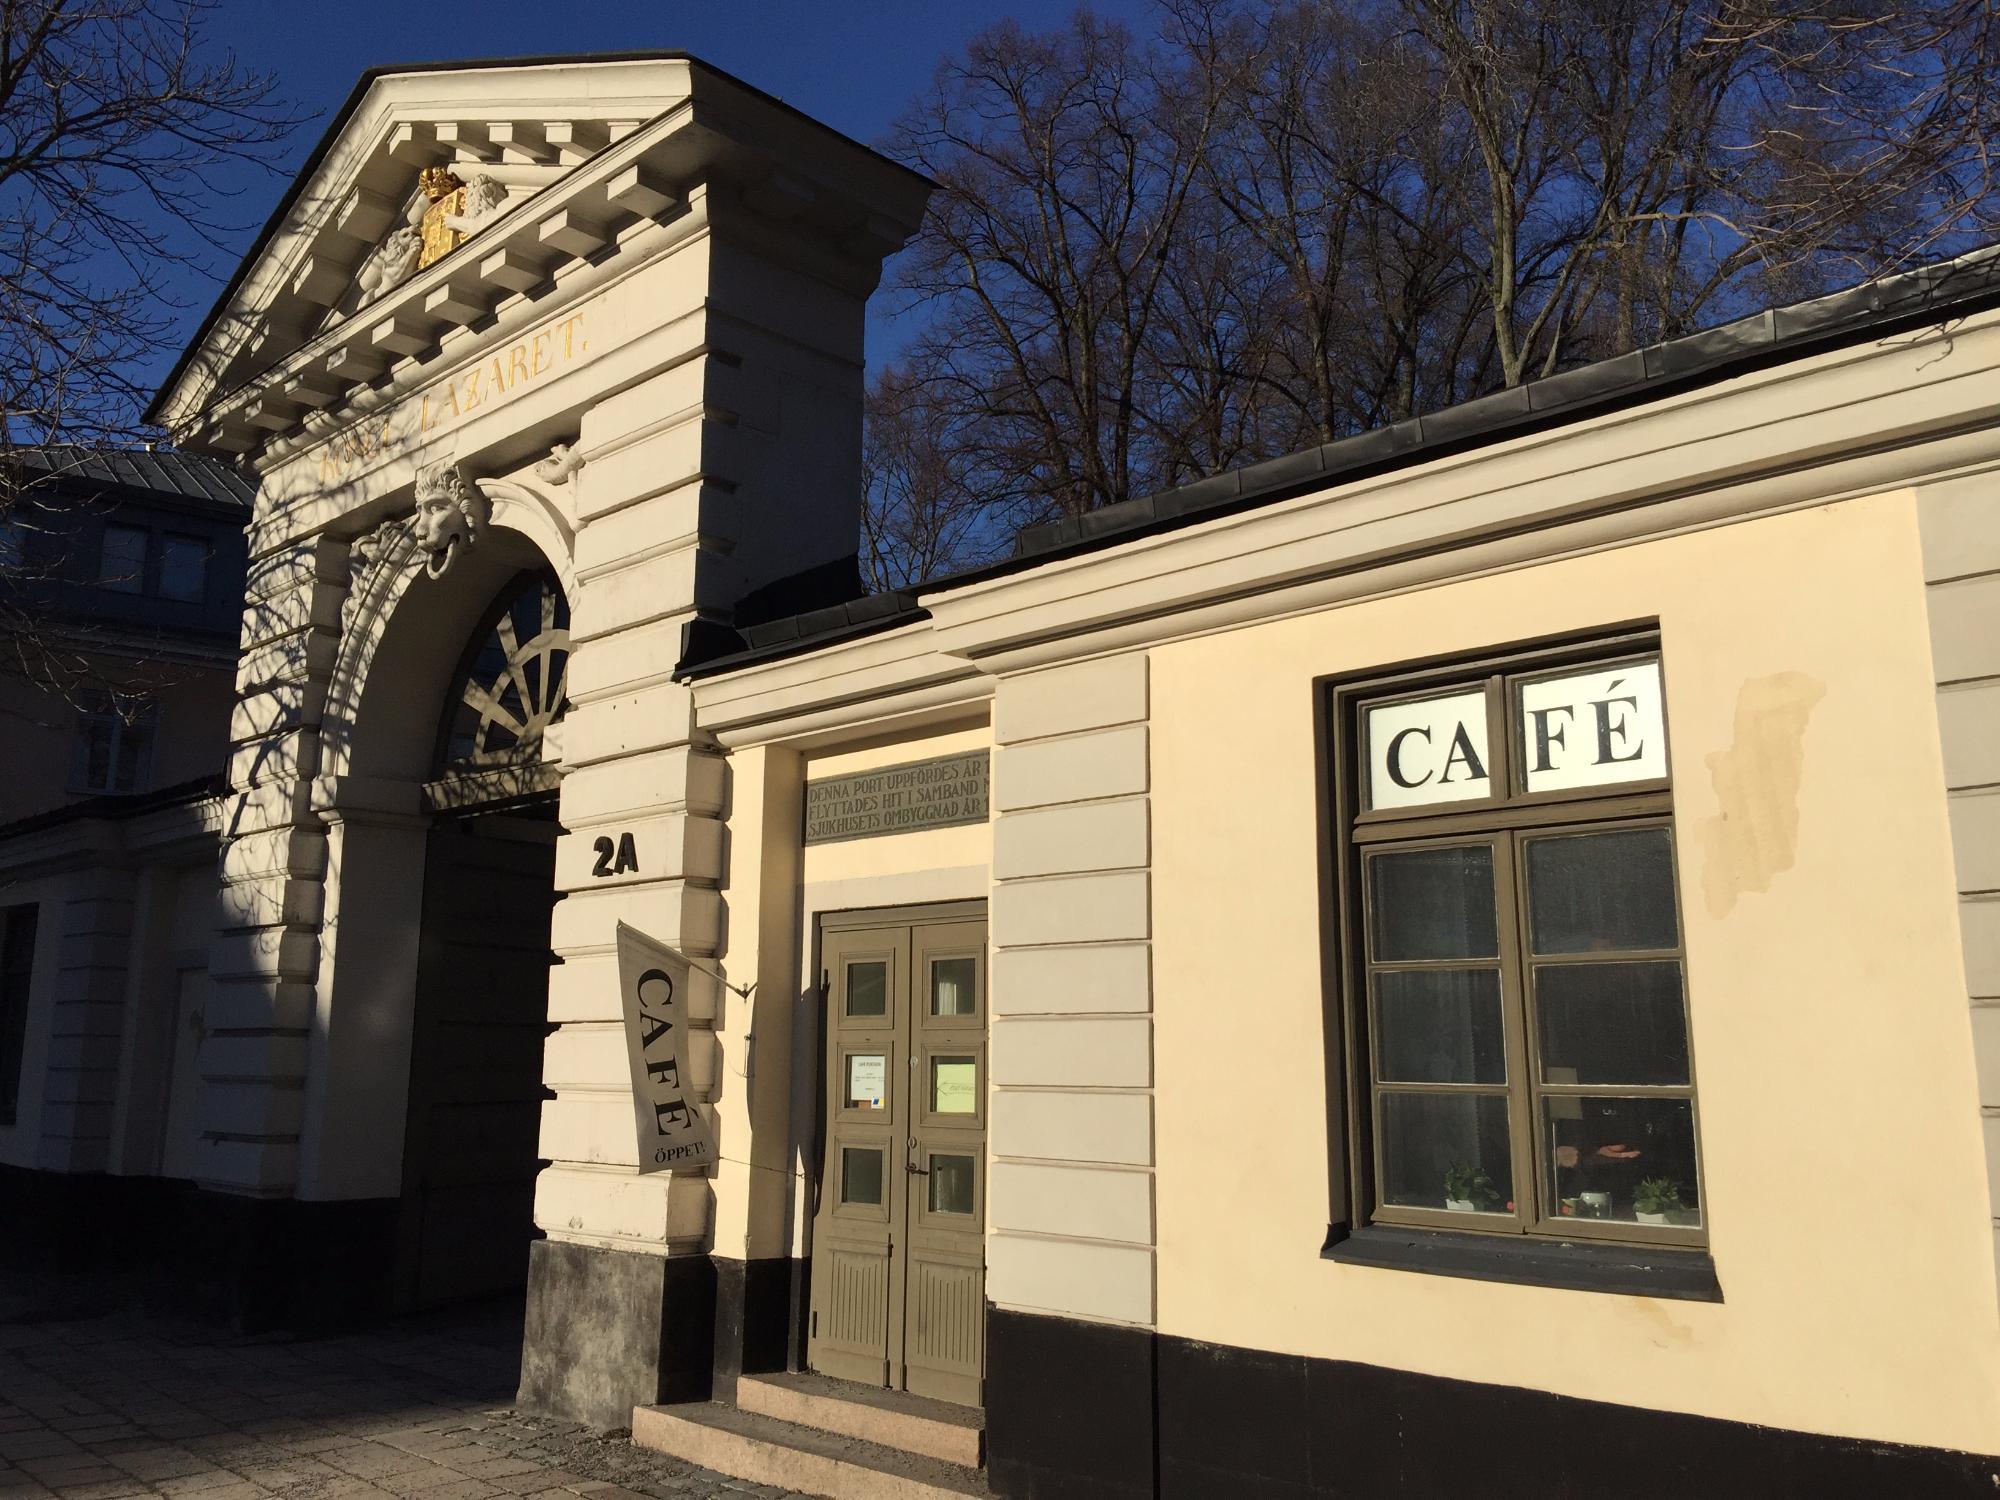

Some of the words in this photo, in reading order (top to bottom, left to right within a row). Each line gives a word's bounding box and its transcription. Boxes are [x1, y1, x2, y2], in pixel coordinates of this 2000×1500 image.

[808, 795, 879, 821] FLYTTADES
[882, 790, 905, 809] HIT
[917, 781, 979, 803] SAMBAND
[809, 784, 850, 804] DENNA
[854, 777, 884, 796] PORT
[887, 764, 960, 790] UPPFÖRDES
[963, 760, 982, 778] ÅR
[808, 813, 882, 838] SJUKHUSETS
[884, 802, 959, 826] OMBYGGNAD
[962, 799, 981, 816] ÅR
[592, 832, 640, 878] 2A
[636, 967, 699, 1136] CAFÉ
[654, 1140, 707, 1164] ÖPPET!
